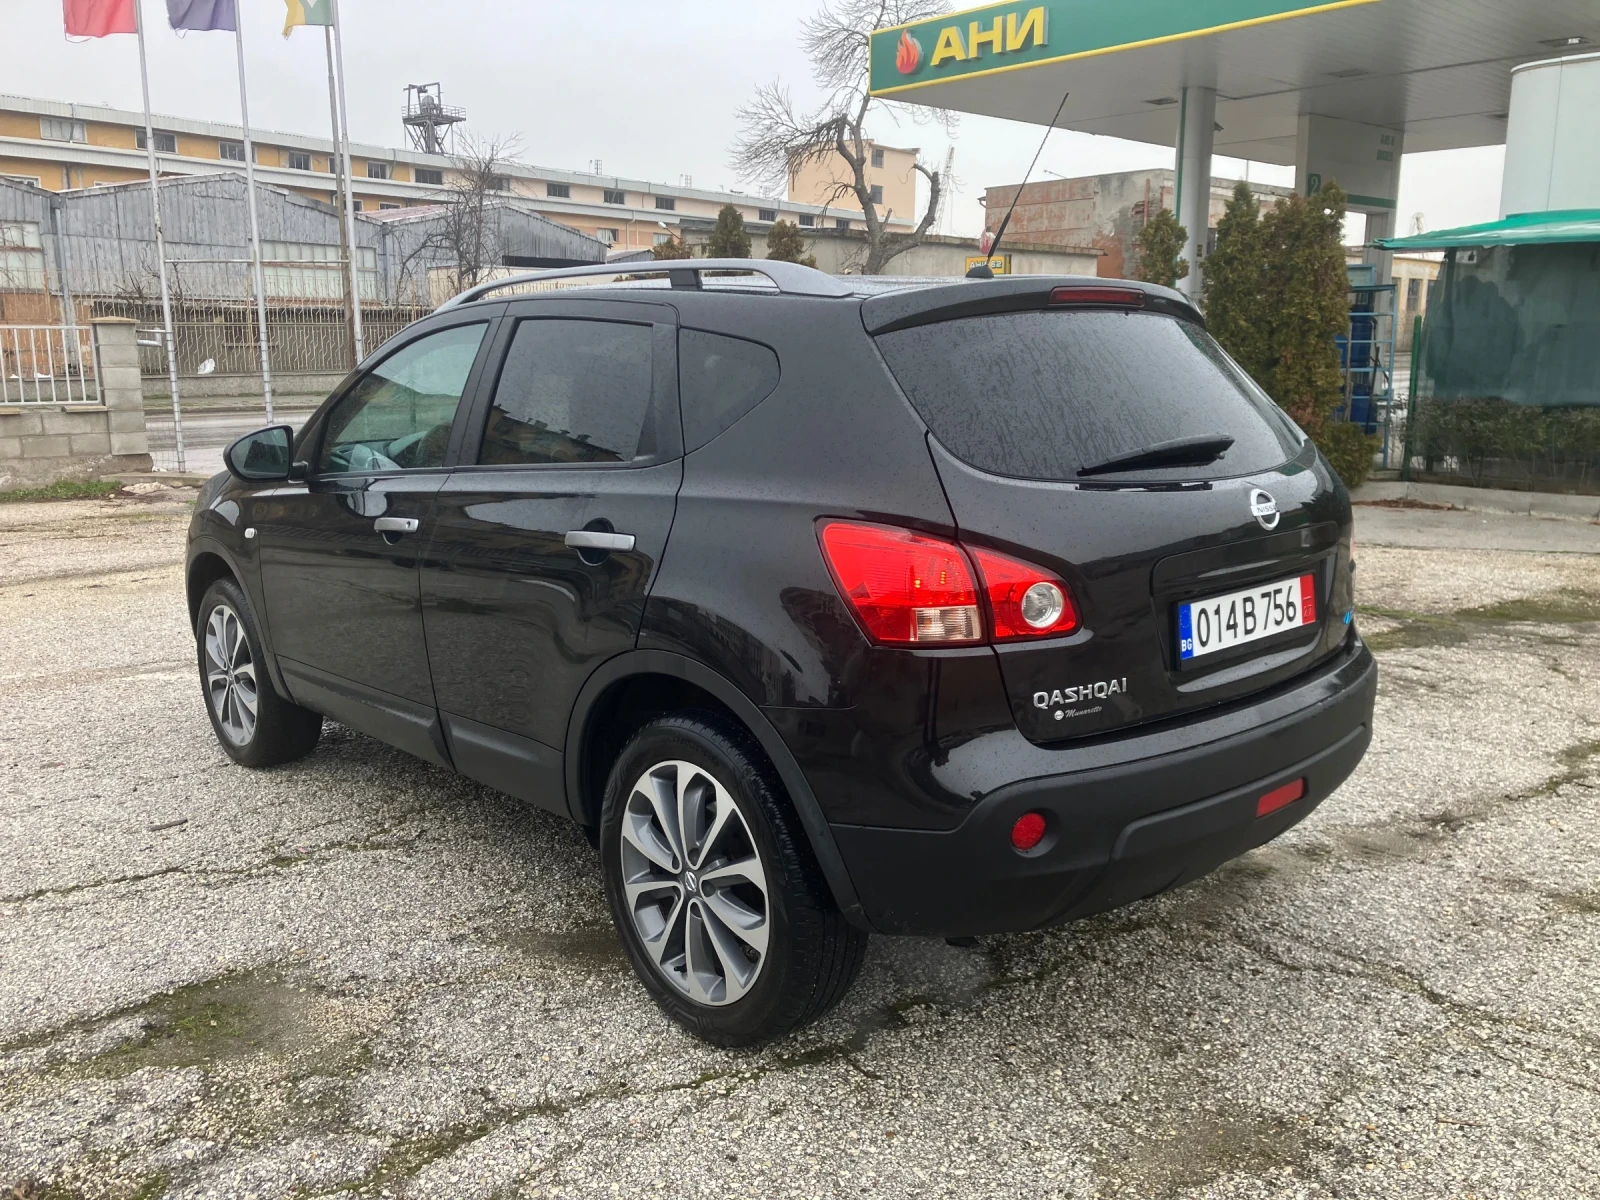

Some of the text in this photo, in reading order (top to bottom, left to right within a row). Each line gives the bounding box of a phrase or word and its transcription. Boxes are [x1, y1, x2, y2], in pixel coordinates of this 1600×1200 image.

[930, 6, 1047, 66] АНИ
[1311, 176, 1319, 195] 2
[1257, 504, 1277, 513] NISS
[1197, 585, 1297, 648] 014B756
[1181, 638, 1192, 652] BG
[1033, 677, 1127, 709] QASHQAI
